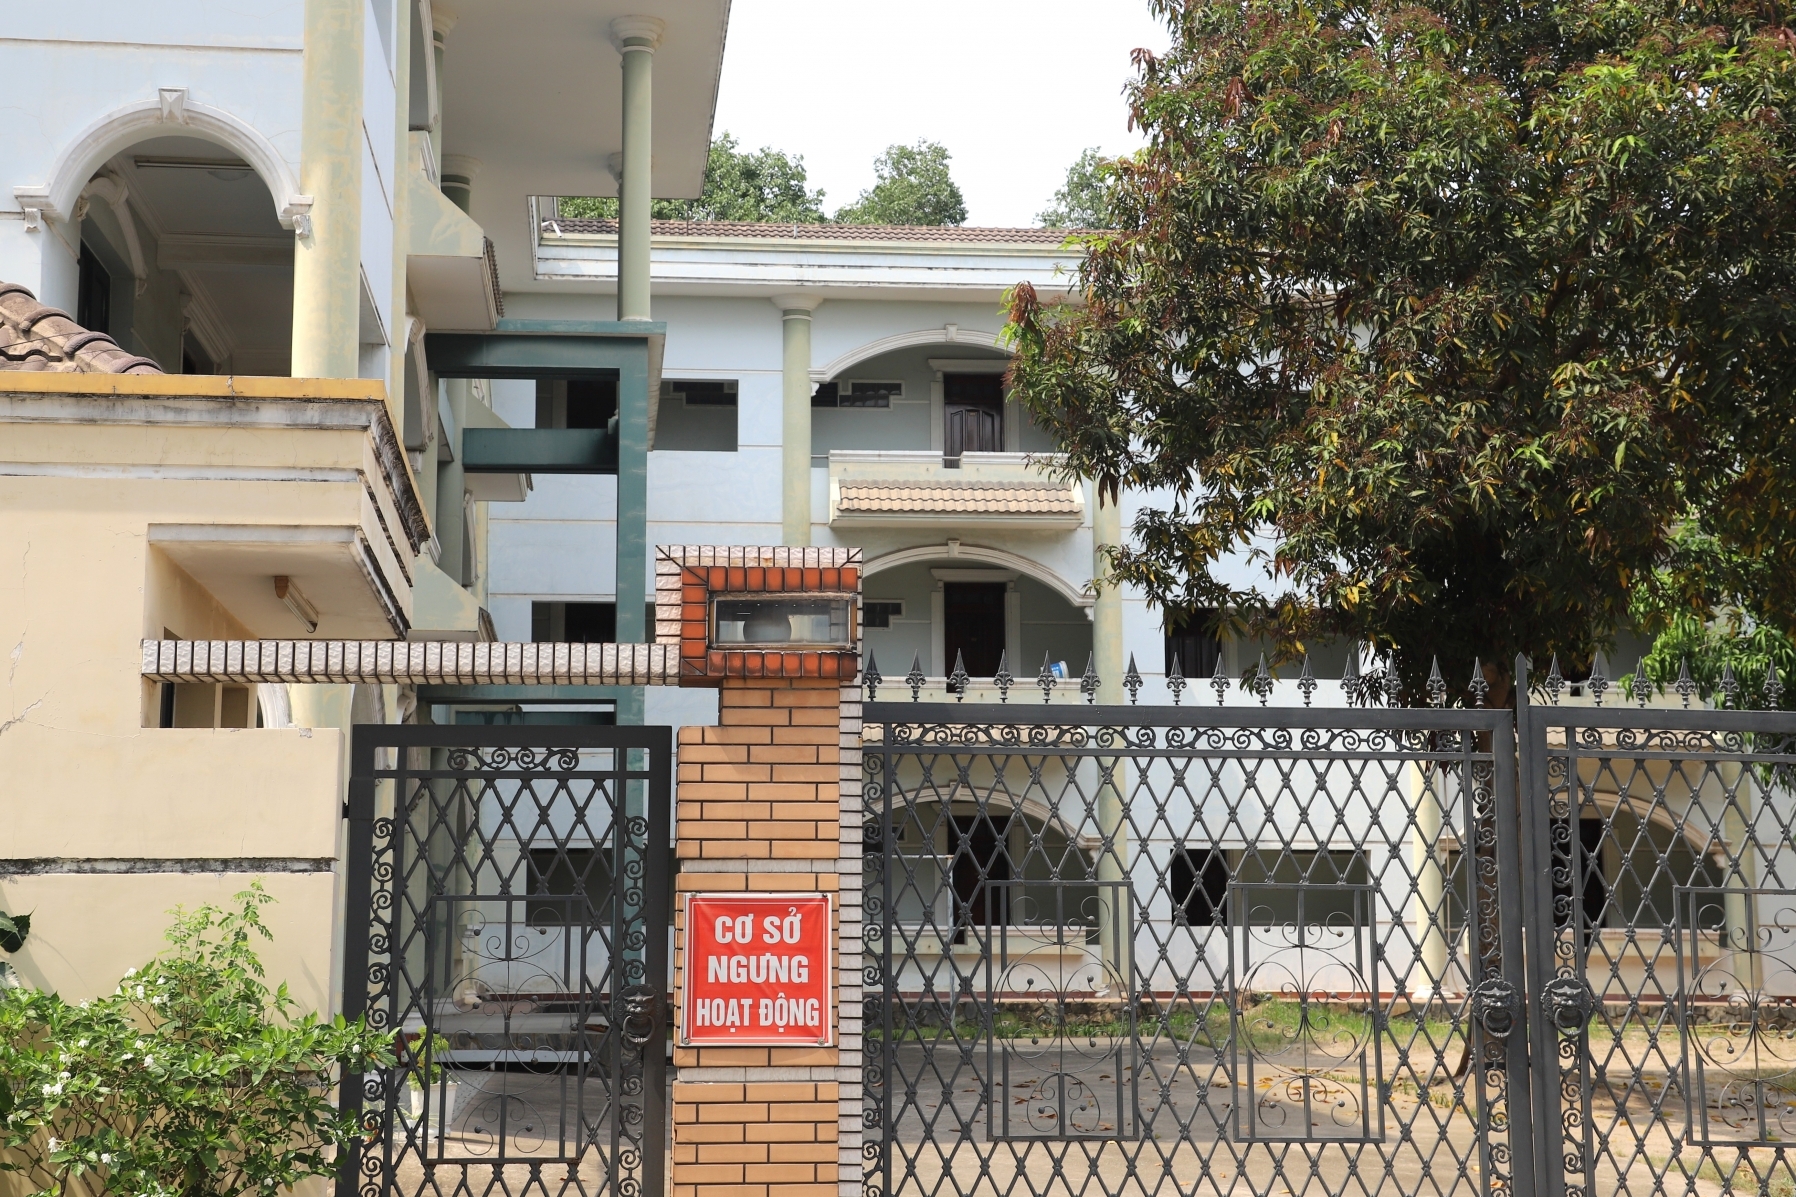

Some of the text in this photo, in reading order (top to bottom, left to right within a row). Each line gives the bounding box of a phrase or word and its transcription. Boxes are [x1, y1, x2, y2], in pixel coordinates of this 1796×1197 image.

[714, 906, 802, 944] CƠ SỞ
[707, 952, 809, 984] NGƯNG
[696, 992, 820, 1033] HOẠT ĐỘNG
